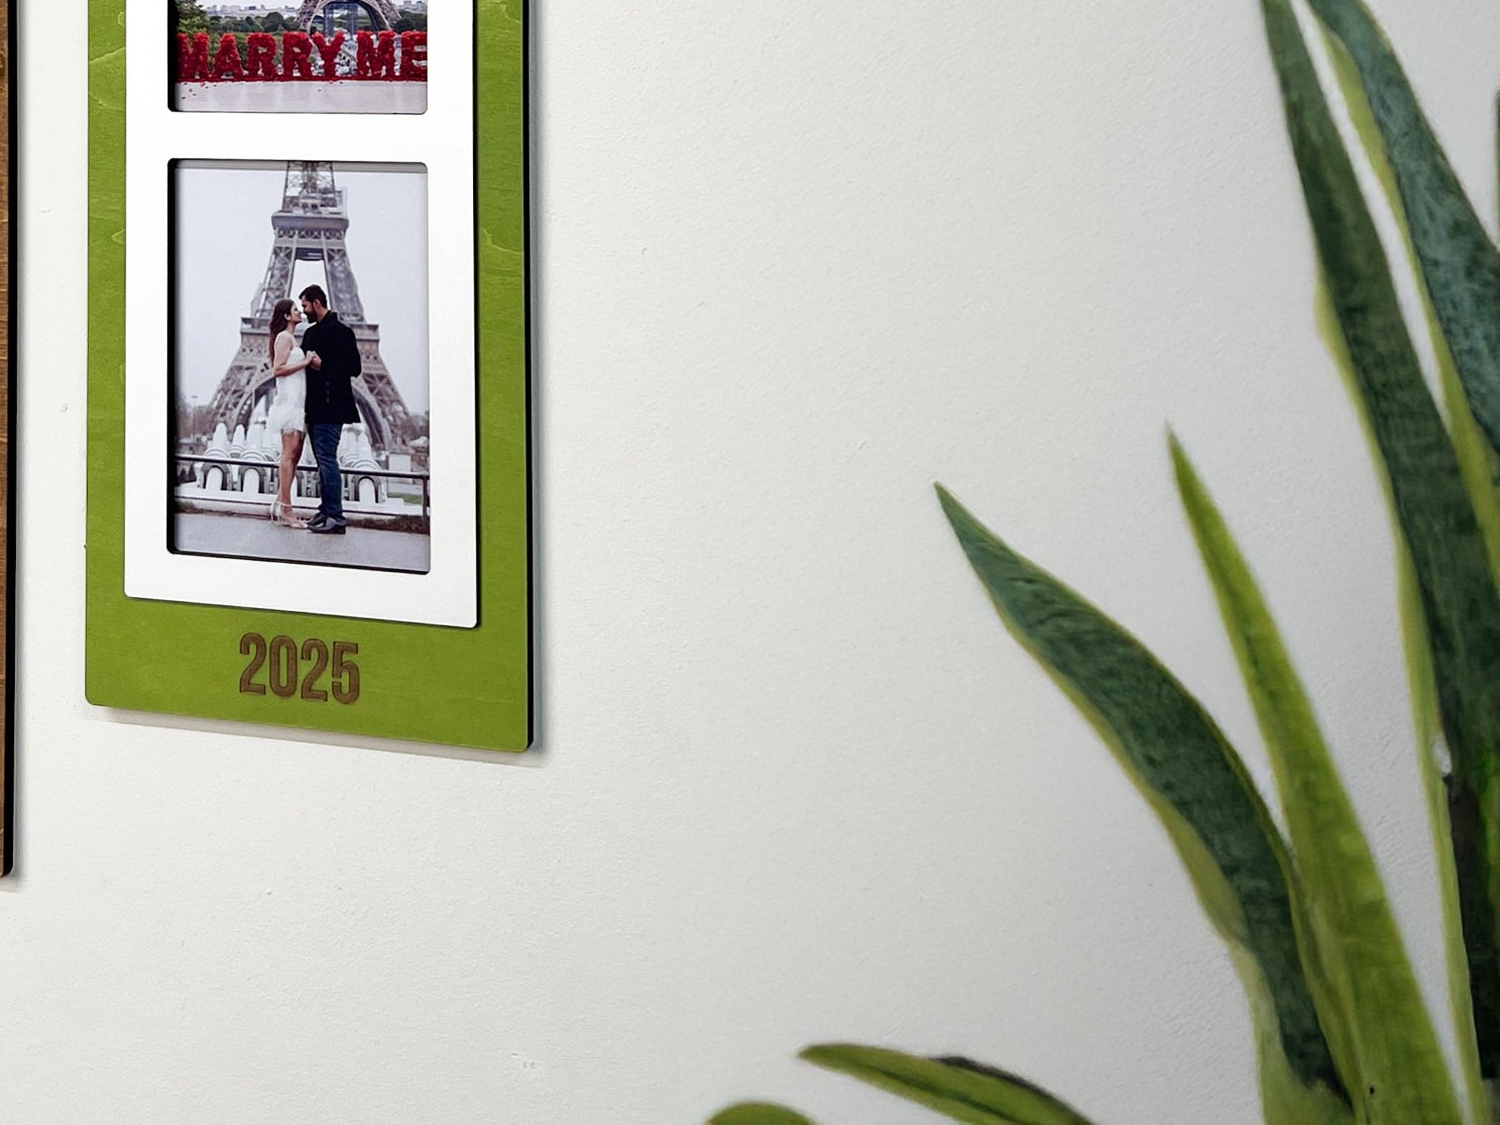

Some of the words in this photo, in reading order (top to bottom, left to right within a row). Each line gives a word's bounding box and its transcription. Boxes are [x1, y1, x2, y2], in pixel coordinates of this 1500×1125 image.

[176, 30, 346, 79] MARRY
[356, 29, 428, 79] ME
[239, 632, 361, 705] 2025
